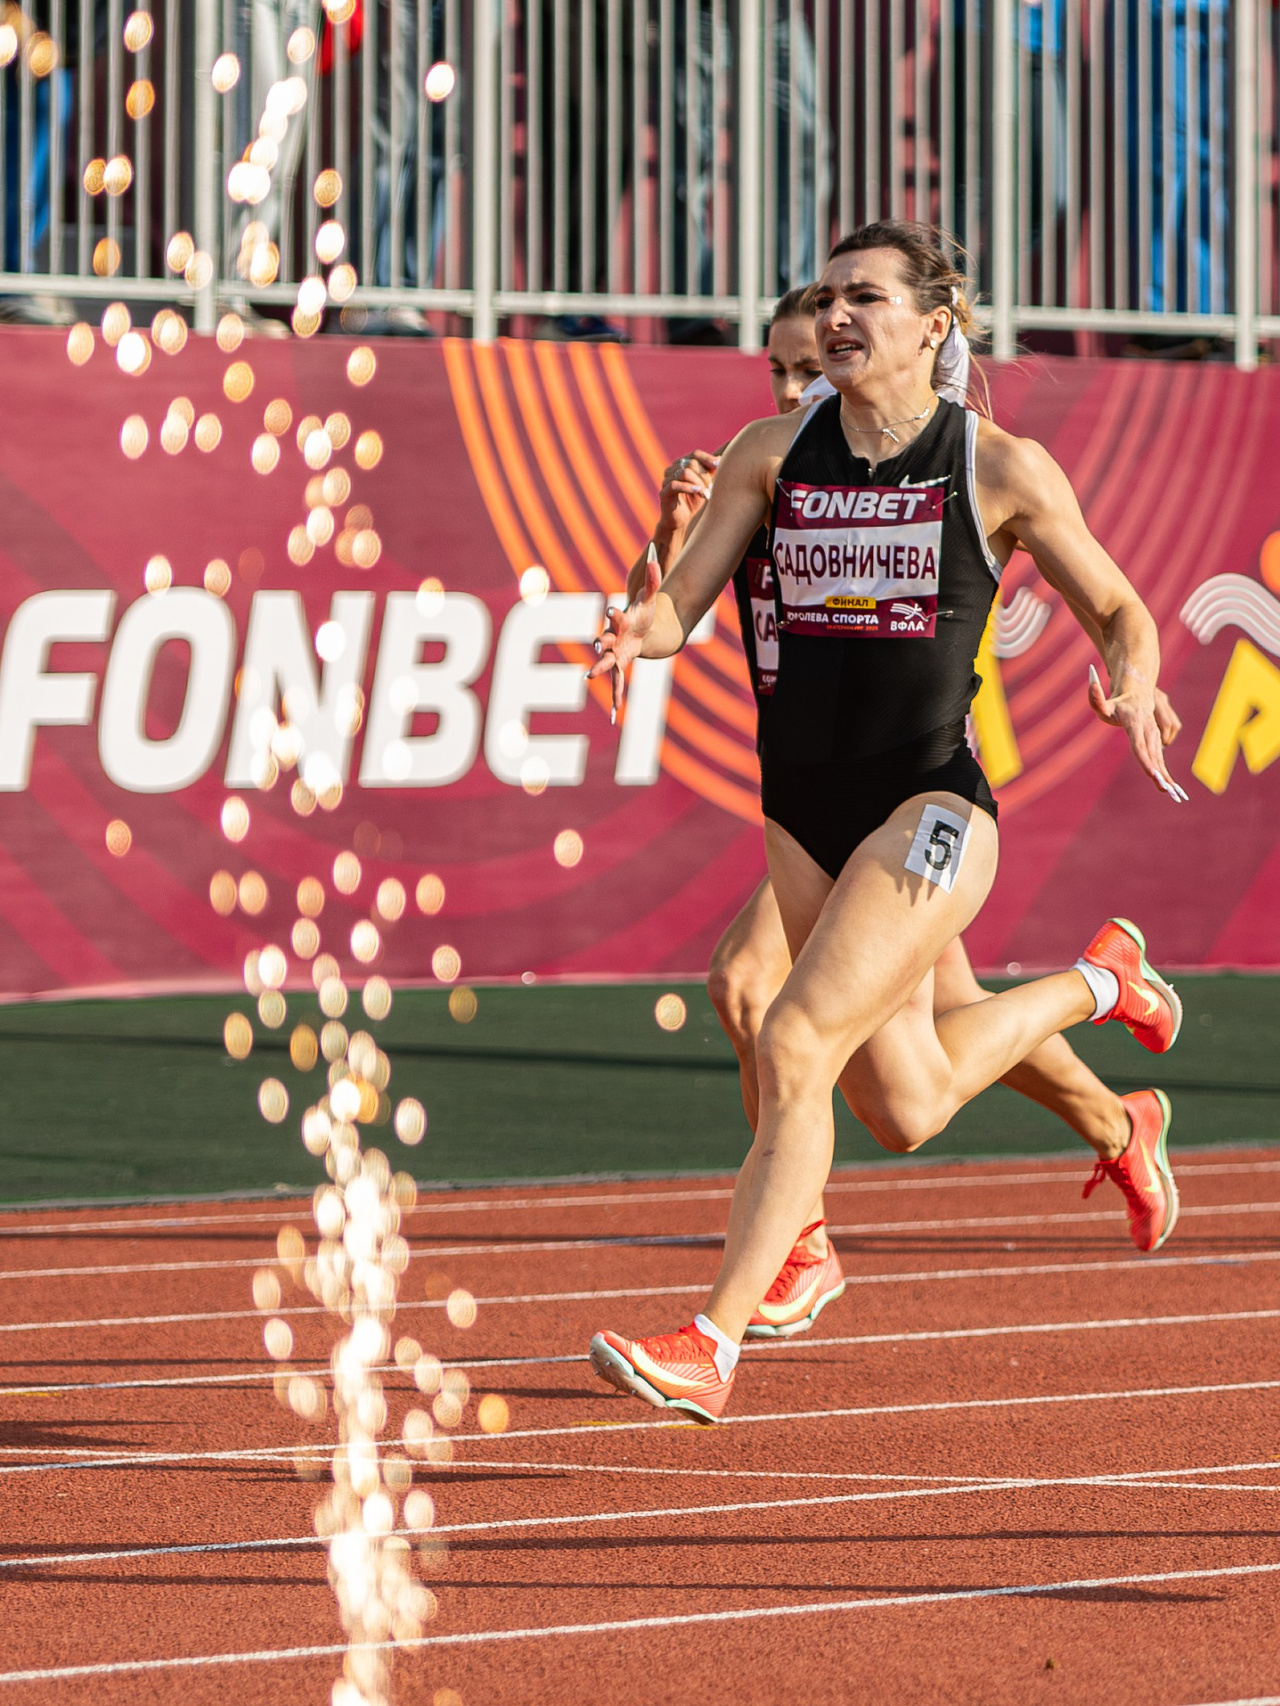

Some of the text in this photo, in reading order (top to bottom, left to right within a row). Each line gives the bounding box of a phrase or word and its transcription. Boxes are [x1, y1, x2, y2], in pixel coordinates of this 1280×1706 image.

[790, 489, 926, 521] FONBET
[774, 541, 937, 586] САДОВНИЧЕВА
[831, 597, 870, 607] ФИНАЛ
[832, 613, 879, 625] СПОРТА
[890, 620, 926, 632] ВФЛА
[0, 586, 718, 793] FONBET
[924, 819, 960, 871] 5
